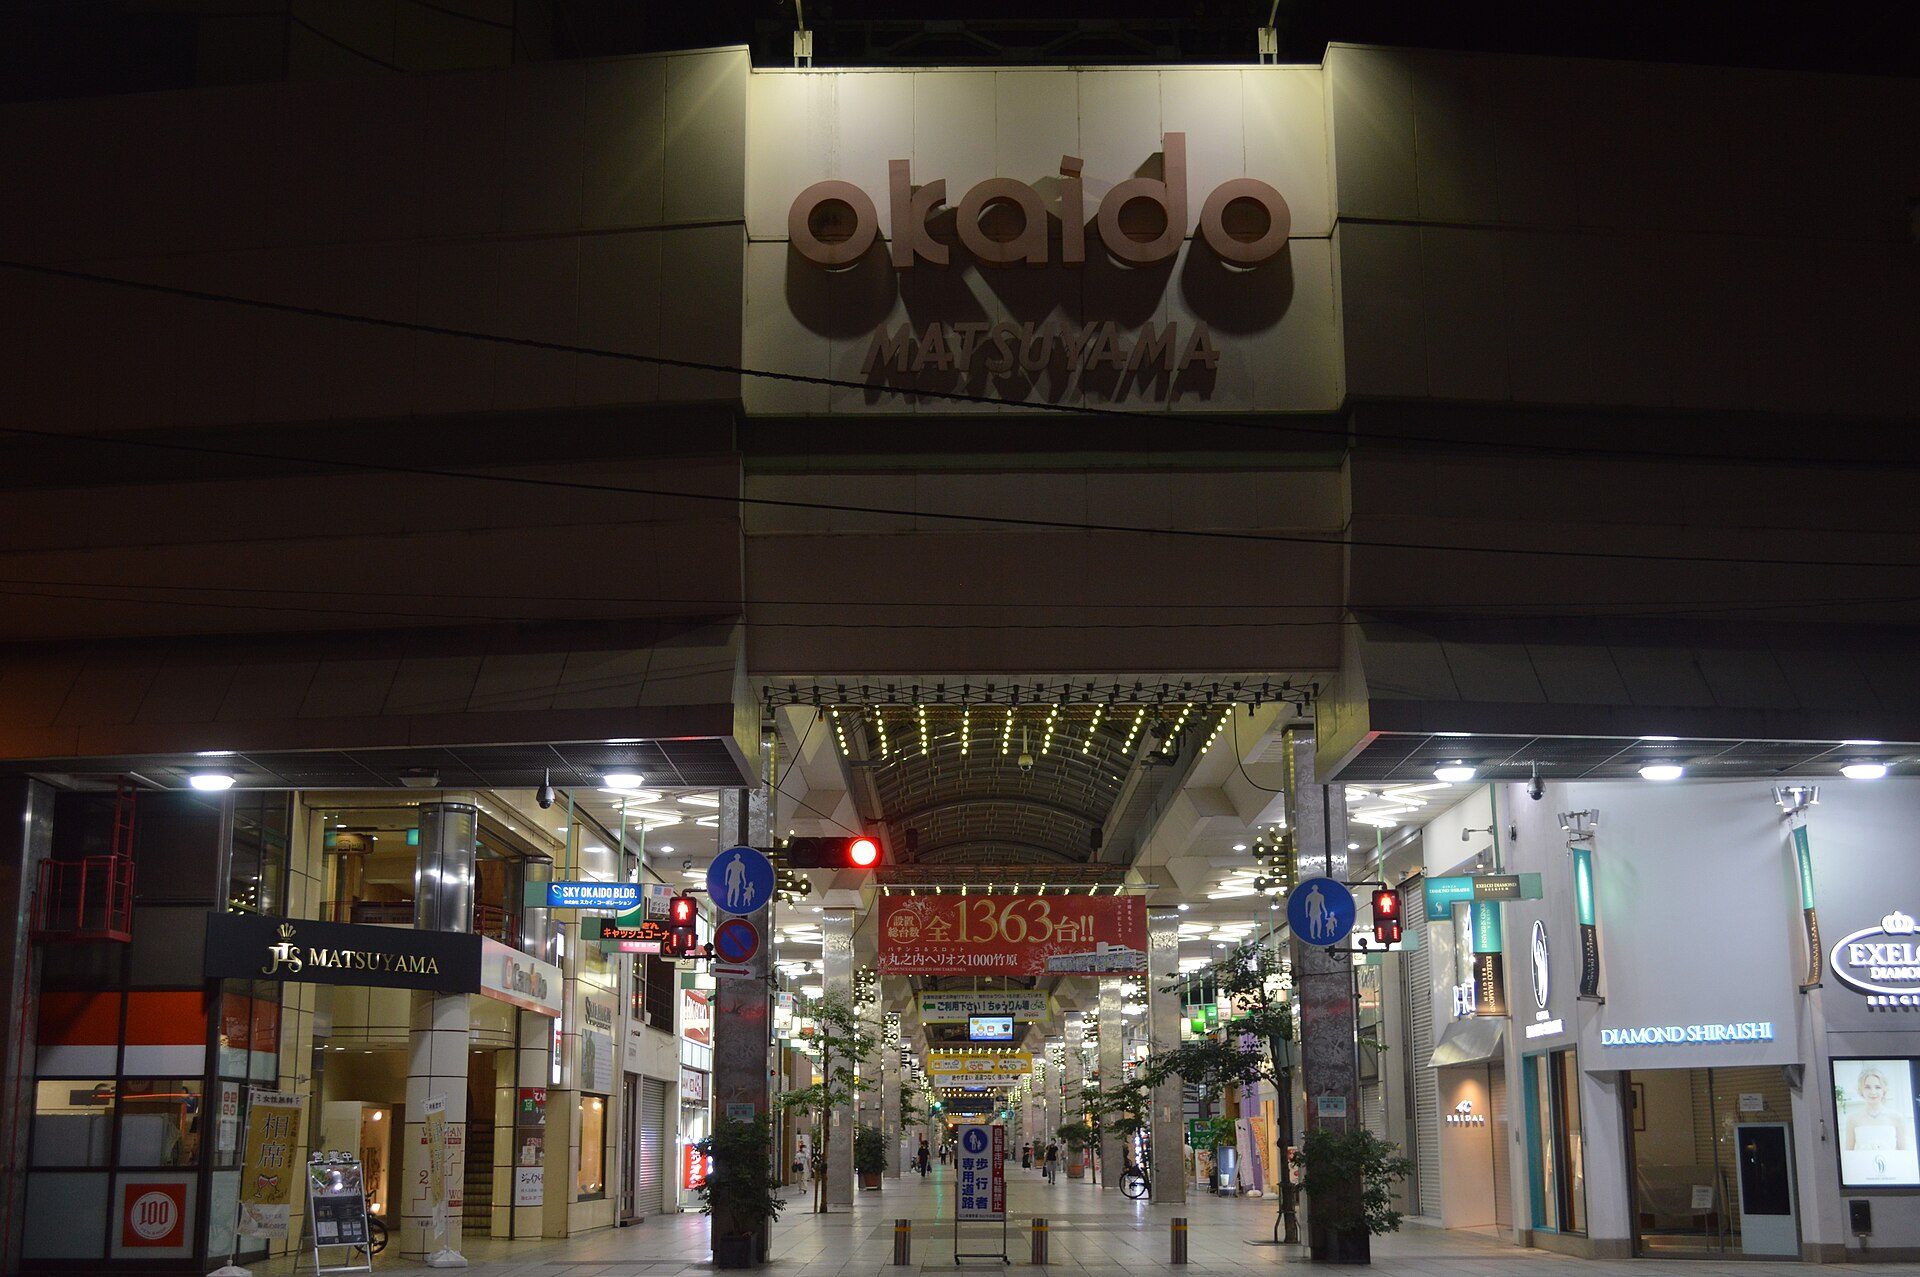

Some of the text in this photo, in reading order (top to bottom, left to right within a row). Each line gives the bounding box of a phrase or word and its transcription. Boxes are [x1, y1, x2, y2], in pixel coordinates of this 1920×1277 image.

[788, 132, 1291, 274] okaido
[861, 320, 1220, 375] MATSUYAMA
[563, 886, 637, 899] SKY OKAIDO BLDG.
[308, 947, 440, 975] MATSUYAMA
[1848, 944, 1920, 966] EXEL
[1486, 955, 1496, 1013] EXELCO DIAMOND
[1600, 1020, 1773, 1047] DIAMOND SHIRAISHI
[1446, 1114, 1484, 1124] BRIDAL
[254, 1112, 290, 1169] 相席
[312, 1150, 352, 1163] 営業中
[962, 1157, 975, 1210] 専用道路
[976, 1157, 989, 1210] 歩行者
[139, 1201, 169, 1226] 100
